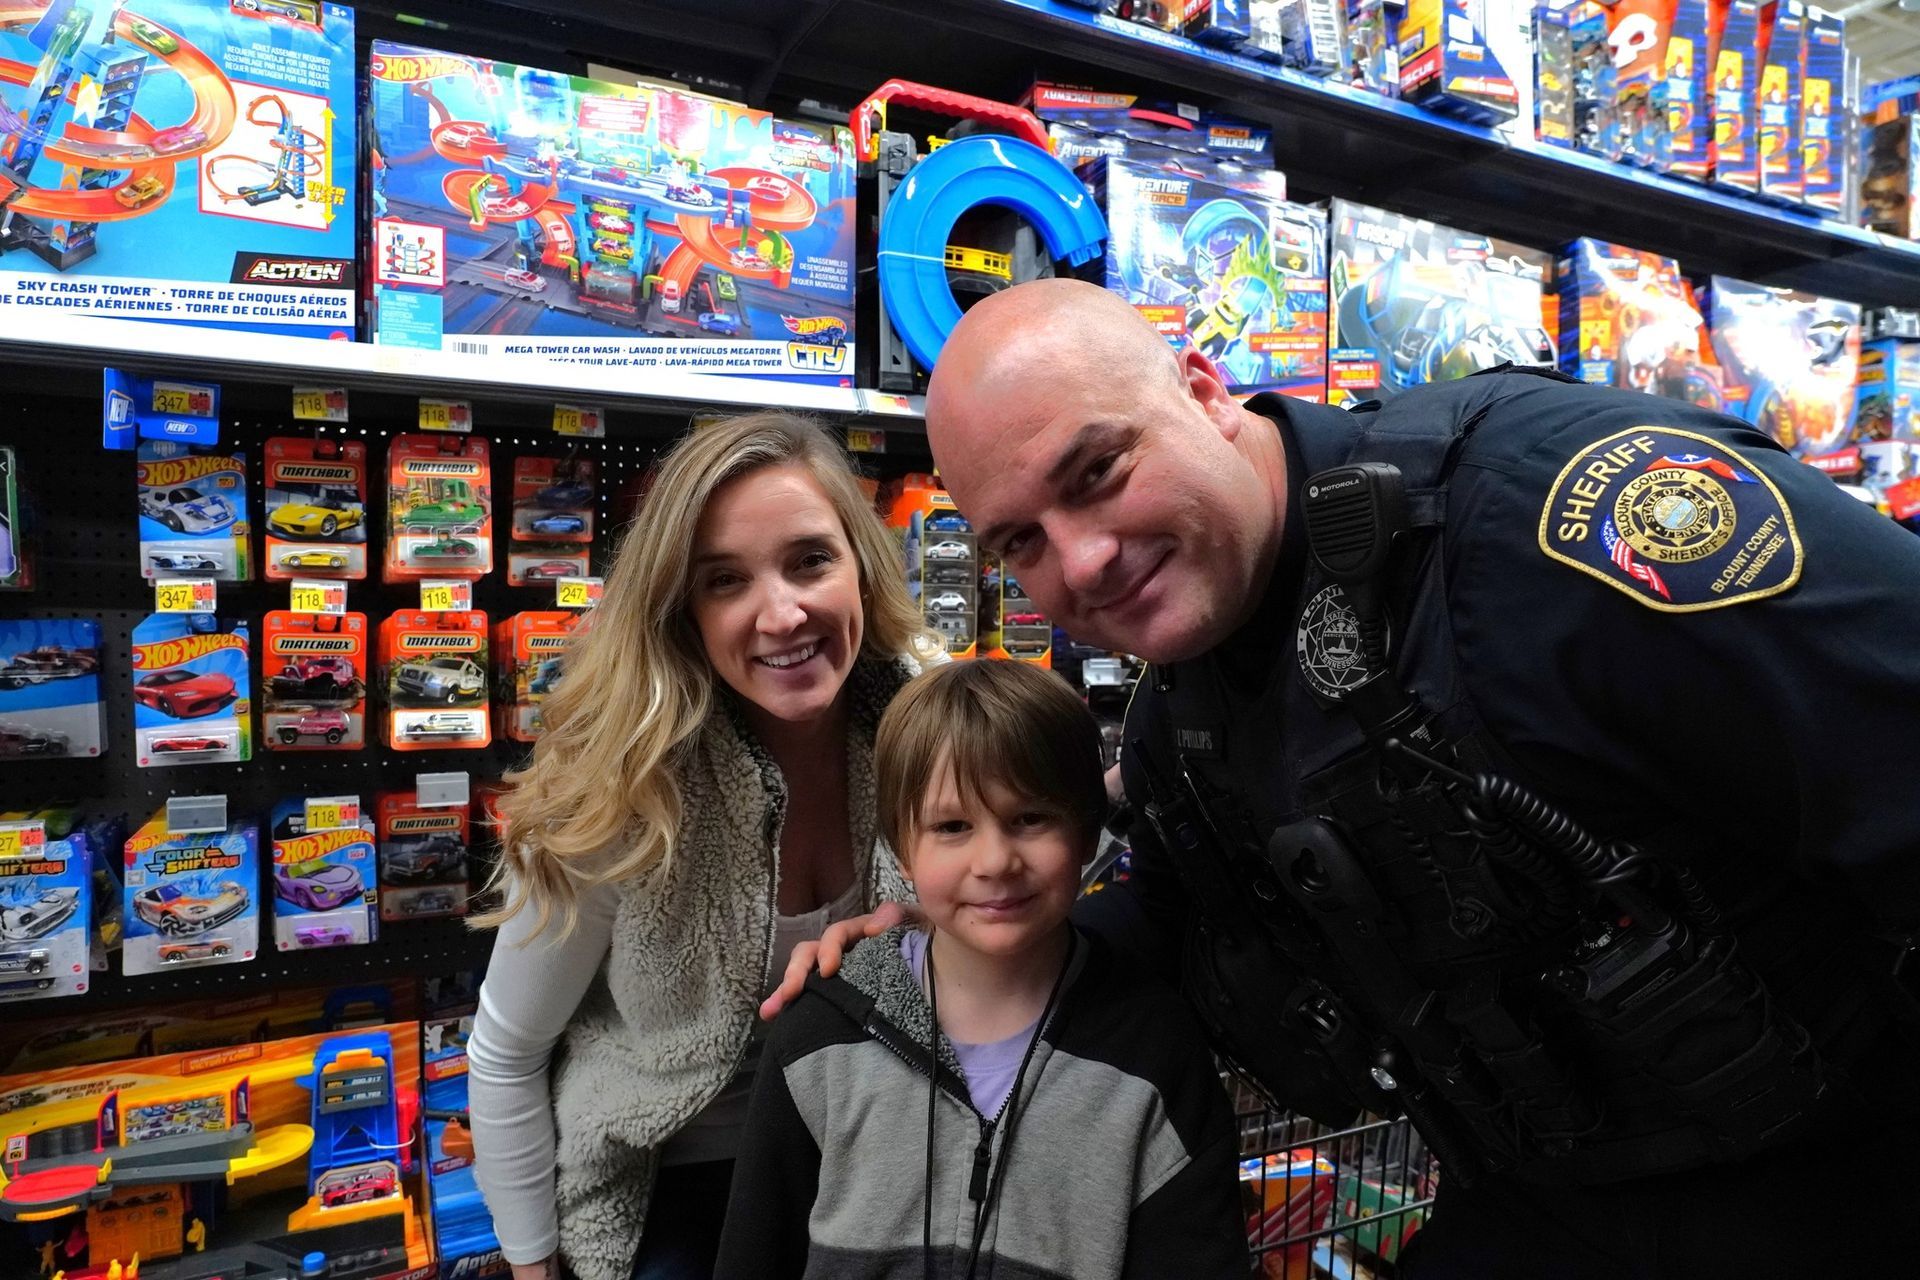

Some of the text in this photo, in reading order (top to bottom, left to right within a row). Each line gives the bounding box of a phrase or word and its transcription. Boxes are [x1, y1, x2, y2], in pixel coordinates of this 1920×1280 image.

[332, 7, 346, 16] 5+
[252, 42, 330, 65] ADULT ASSEMBLY REQUIRED
[286, 58, 298, 66] POR
[807, 256, 848, 268] UNASSEMBLED
[248, 260, 344, 282] ACTION
[800, 263, 848, 276] DESENSAMBLADO
[792, 277, 814, 286] REQUER
[815, 273, 848, 283] ASSEMBLER
[17, 280, 46, 291] SKY
[51, 282, 97, 294] CRASH
[171, 288, 214, 300] TORRE
[218, 291, 234, 300] DE
[239, 292, 296, 304] CHOQUES
[300, 294, 347, 306] AÉREOS
[17, 295, 90, 308] CASCADES
[95, 297, 172, 311] AÉRIENNES
[186, 303, 228, 314] TORRE
[233, 305, 248, 315] DE
[253, 305, 304, 317] COLISÃO
[308, 307, 347, 319] AÉREA
[505, 346, 533, 354] MEGA
[536, 346, 569, 354] TOWER
[572, 346, 590, 354] CAR
[593, 346, 620, 354] WASH
[680, 345, 728, 355] VEHÍCULOS
[730, 347, 781, 355] MEGATORRE
[606, 358, 656, 366] LAVE-AUTO
[665, 357, 723, 366] LAVA-RÁPIDO
[753, 359, 782, 367] TOWER
[166, 422, 189, 433] NEW
[281, 466, 352, 478] MATCHBOX
[408, 462, 477, 473] MATCHBOX
[1321, 479, 1360, 492] MOTOROLA
[1558, 435, 1656, 542] SHERIFF
[1617, 470, 1686, 537] BLOUNT COUNTY
[1643, 493, 1661, 524] STATE
[1662, 487, 1681, 496] OF
[1659, 487, 1734, 560] SHERIFF'S OFFICE
[1710, 514, 1780, 594] BLOUNT COUNTY
[1734, 533, 1786, 588] TENNESSEE
[162, 590, 187, 609] 347
[561, 586, 583, 602] 247
[1324, 611, 1346, 624] STATE
[280, 639, 351, 650] MATCHBOX
[406, 637, 473, 647] MATCHBOX
[143, 641, 184, 669] HOT
[1320, 652, 1359, 669] TENNESSEE
[395, 818, 456, 829] MATCHBOX
[155, 848, 205, 862] COLOR
[165, 856, 240, 874] SHIFTERS
[51, 1079, 113, 1096] SPEEDWAY
